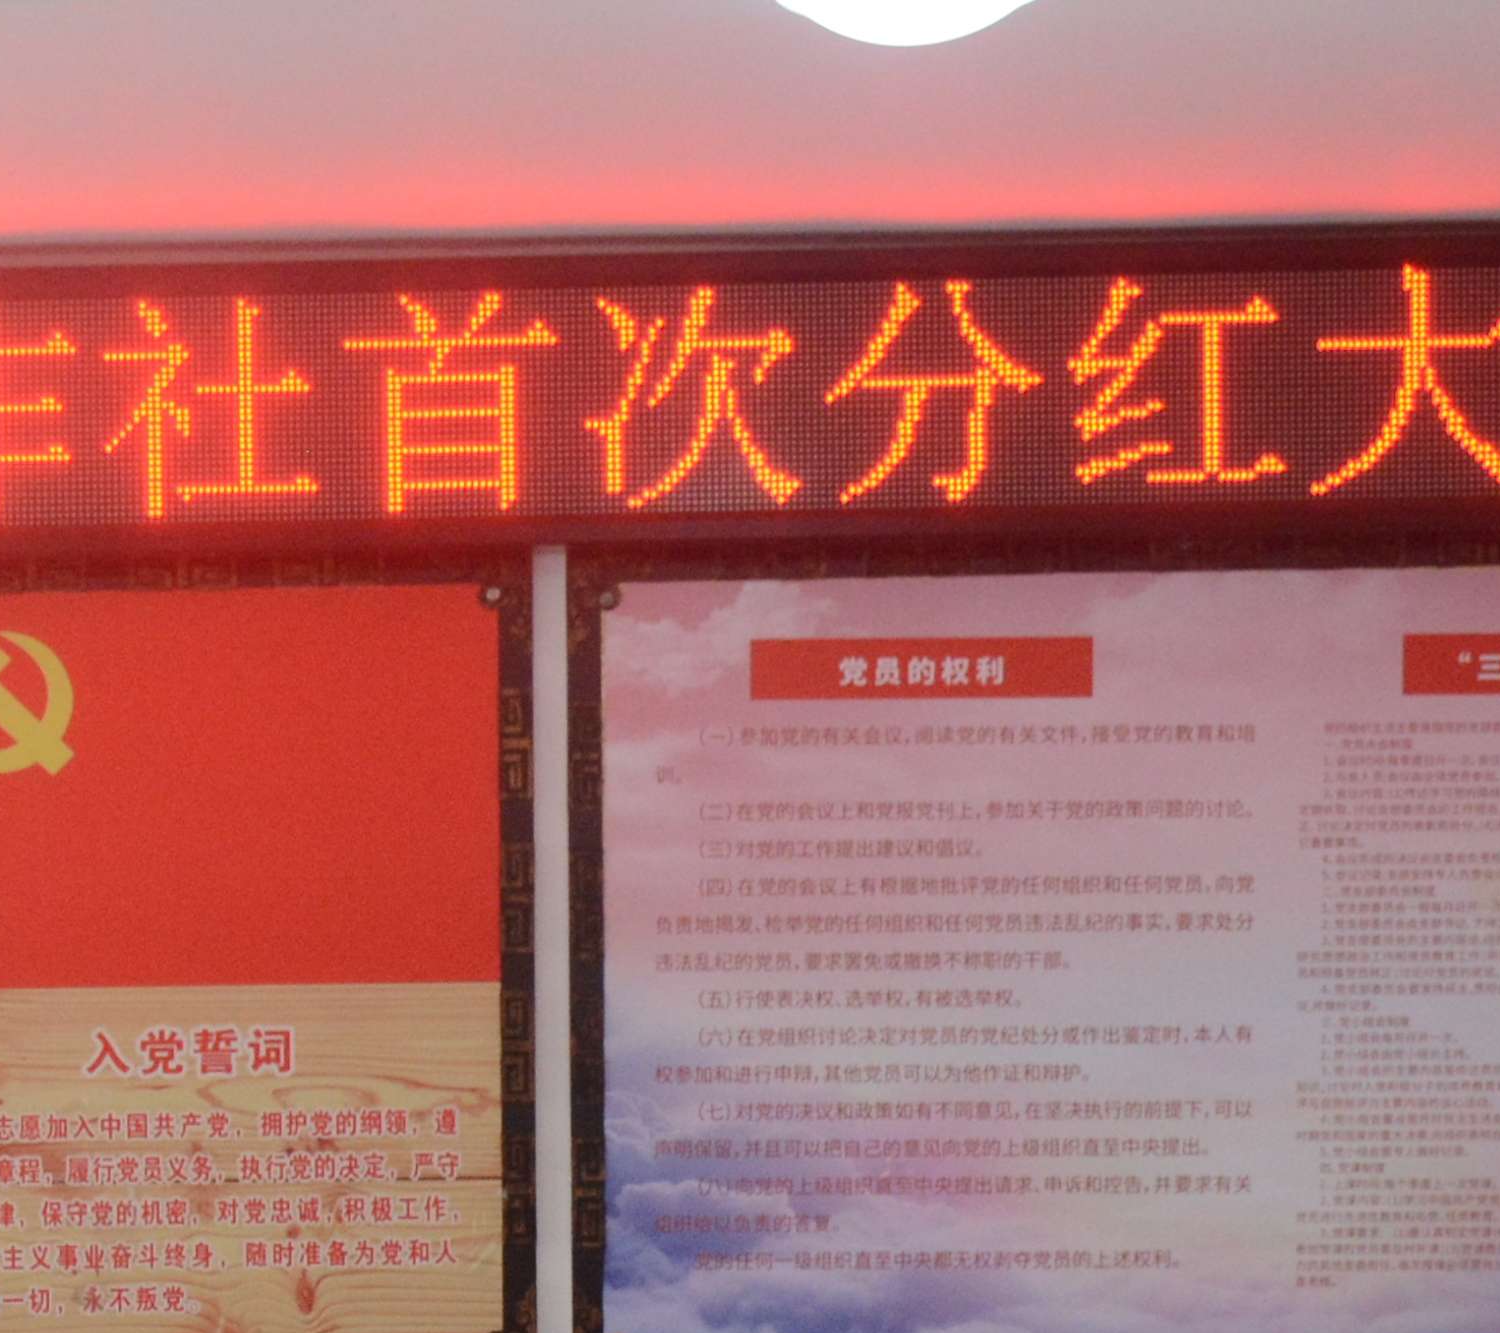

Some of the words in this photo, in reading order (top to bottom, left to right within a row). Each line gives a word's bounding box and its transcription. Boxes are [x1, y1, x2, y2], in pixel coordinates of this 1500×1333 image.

[838, 653, 1008, 686] 党员的权利
[85, 1027, 296, 1076] 入党誓词
